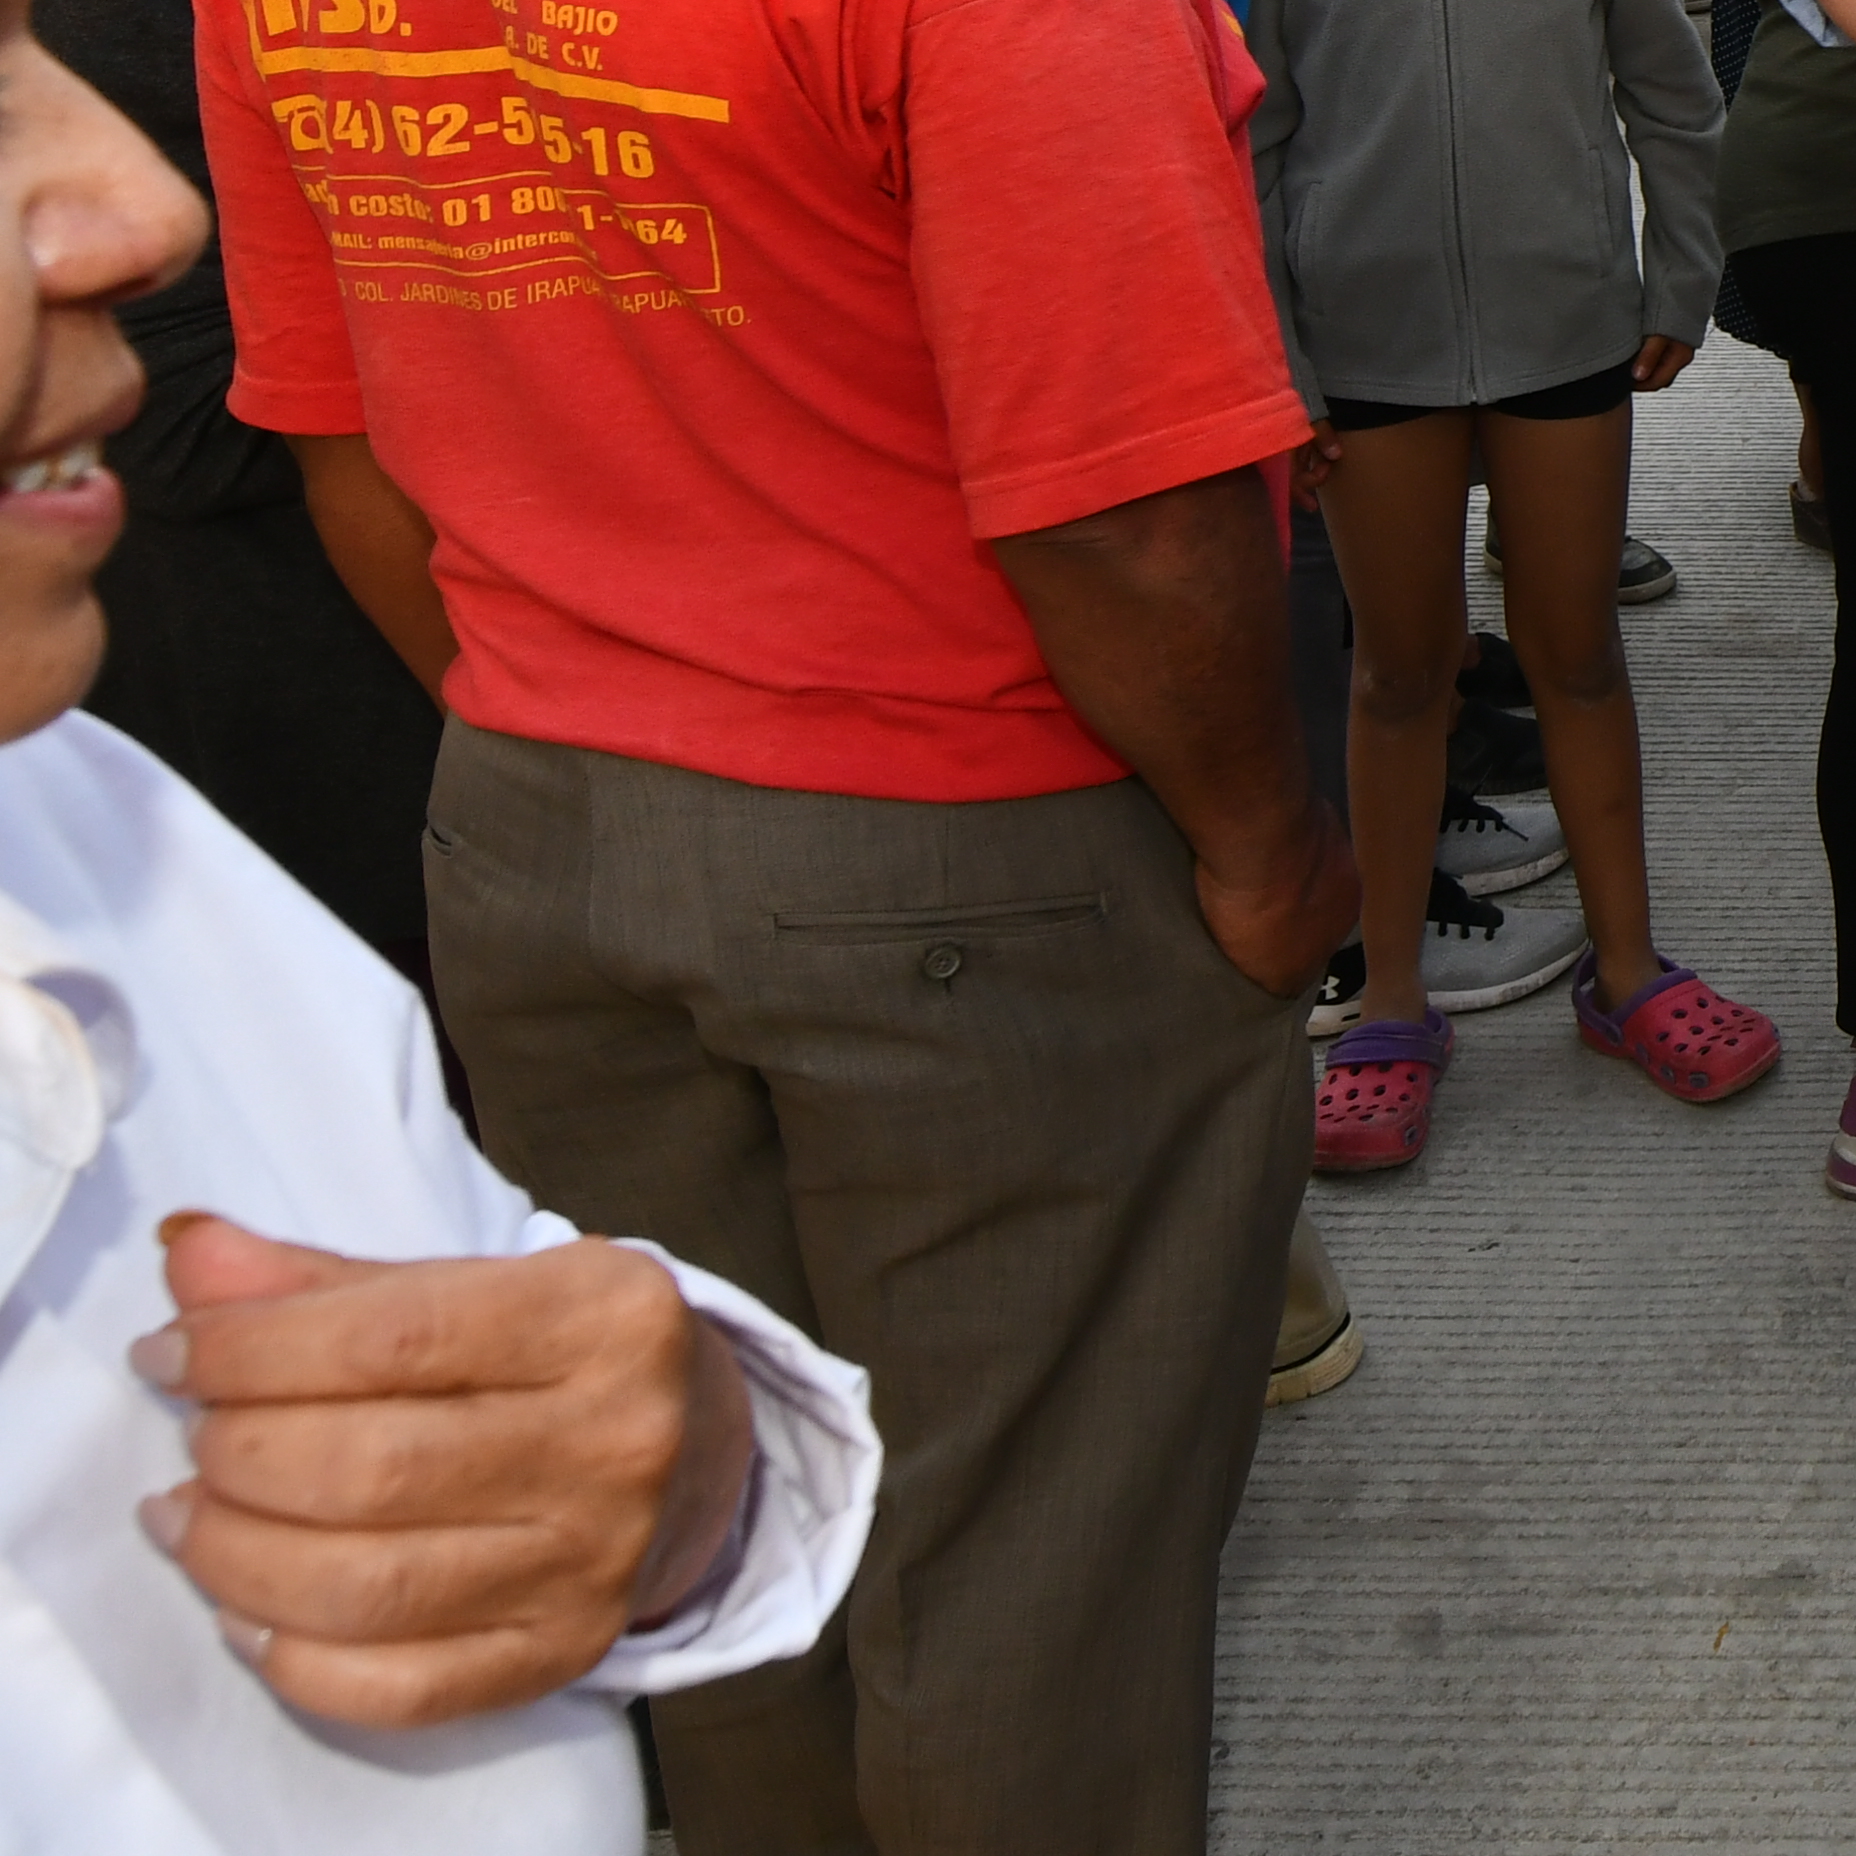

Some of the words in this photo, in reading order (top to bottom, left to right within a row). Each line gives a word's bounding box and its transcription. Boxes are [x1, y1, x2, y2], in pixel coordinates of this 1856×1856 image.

[542, 0, 619, 36] BAJIO
[527, 31, 549, 59] DE
[561, 41, 603, 71] C.V.
[442, 193, 491, 227] 01
[355, 281, 393, 302] COL.
[487, 288, 517, 312] DE
